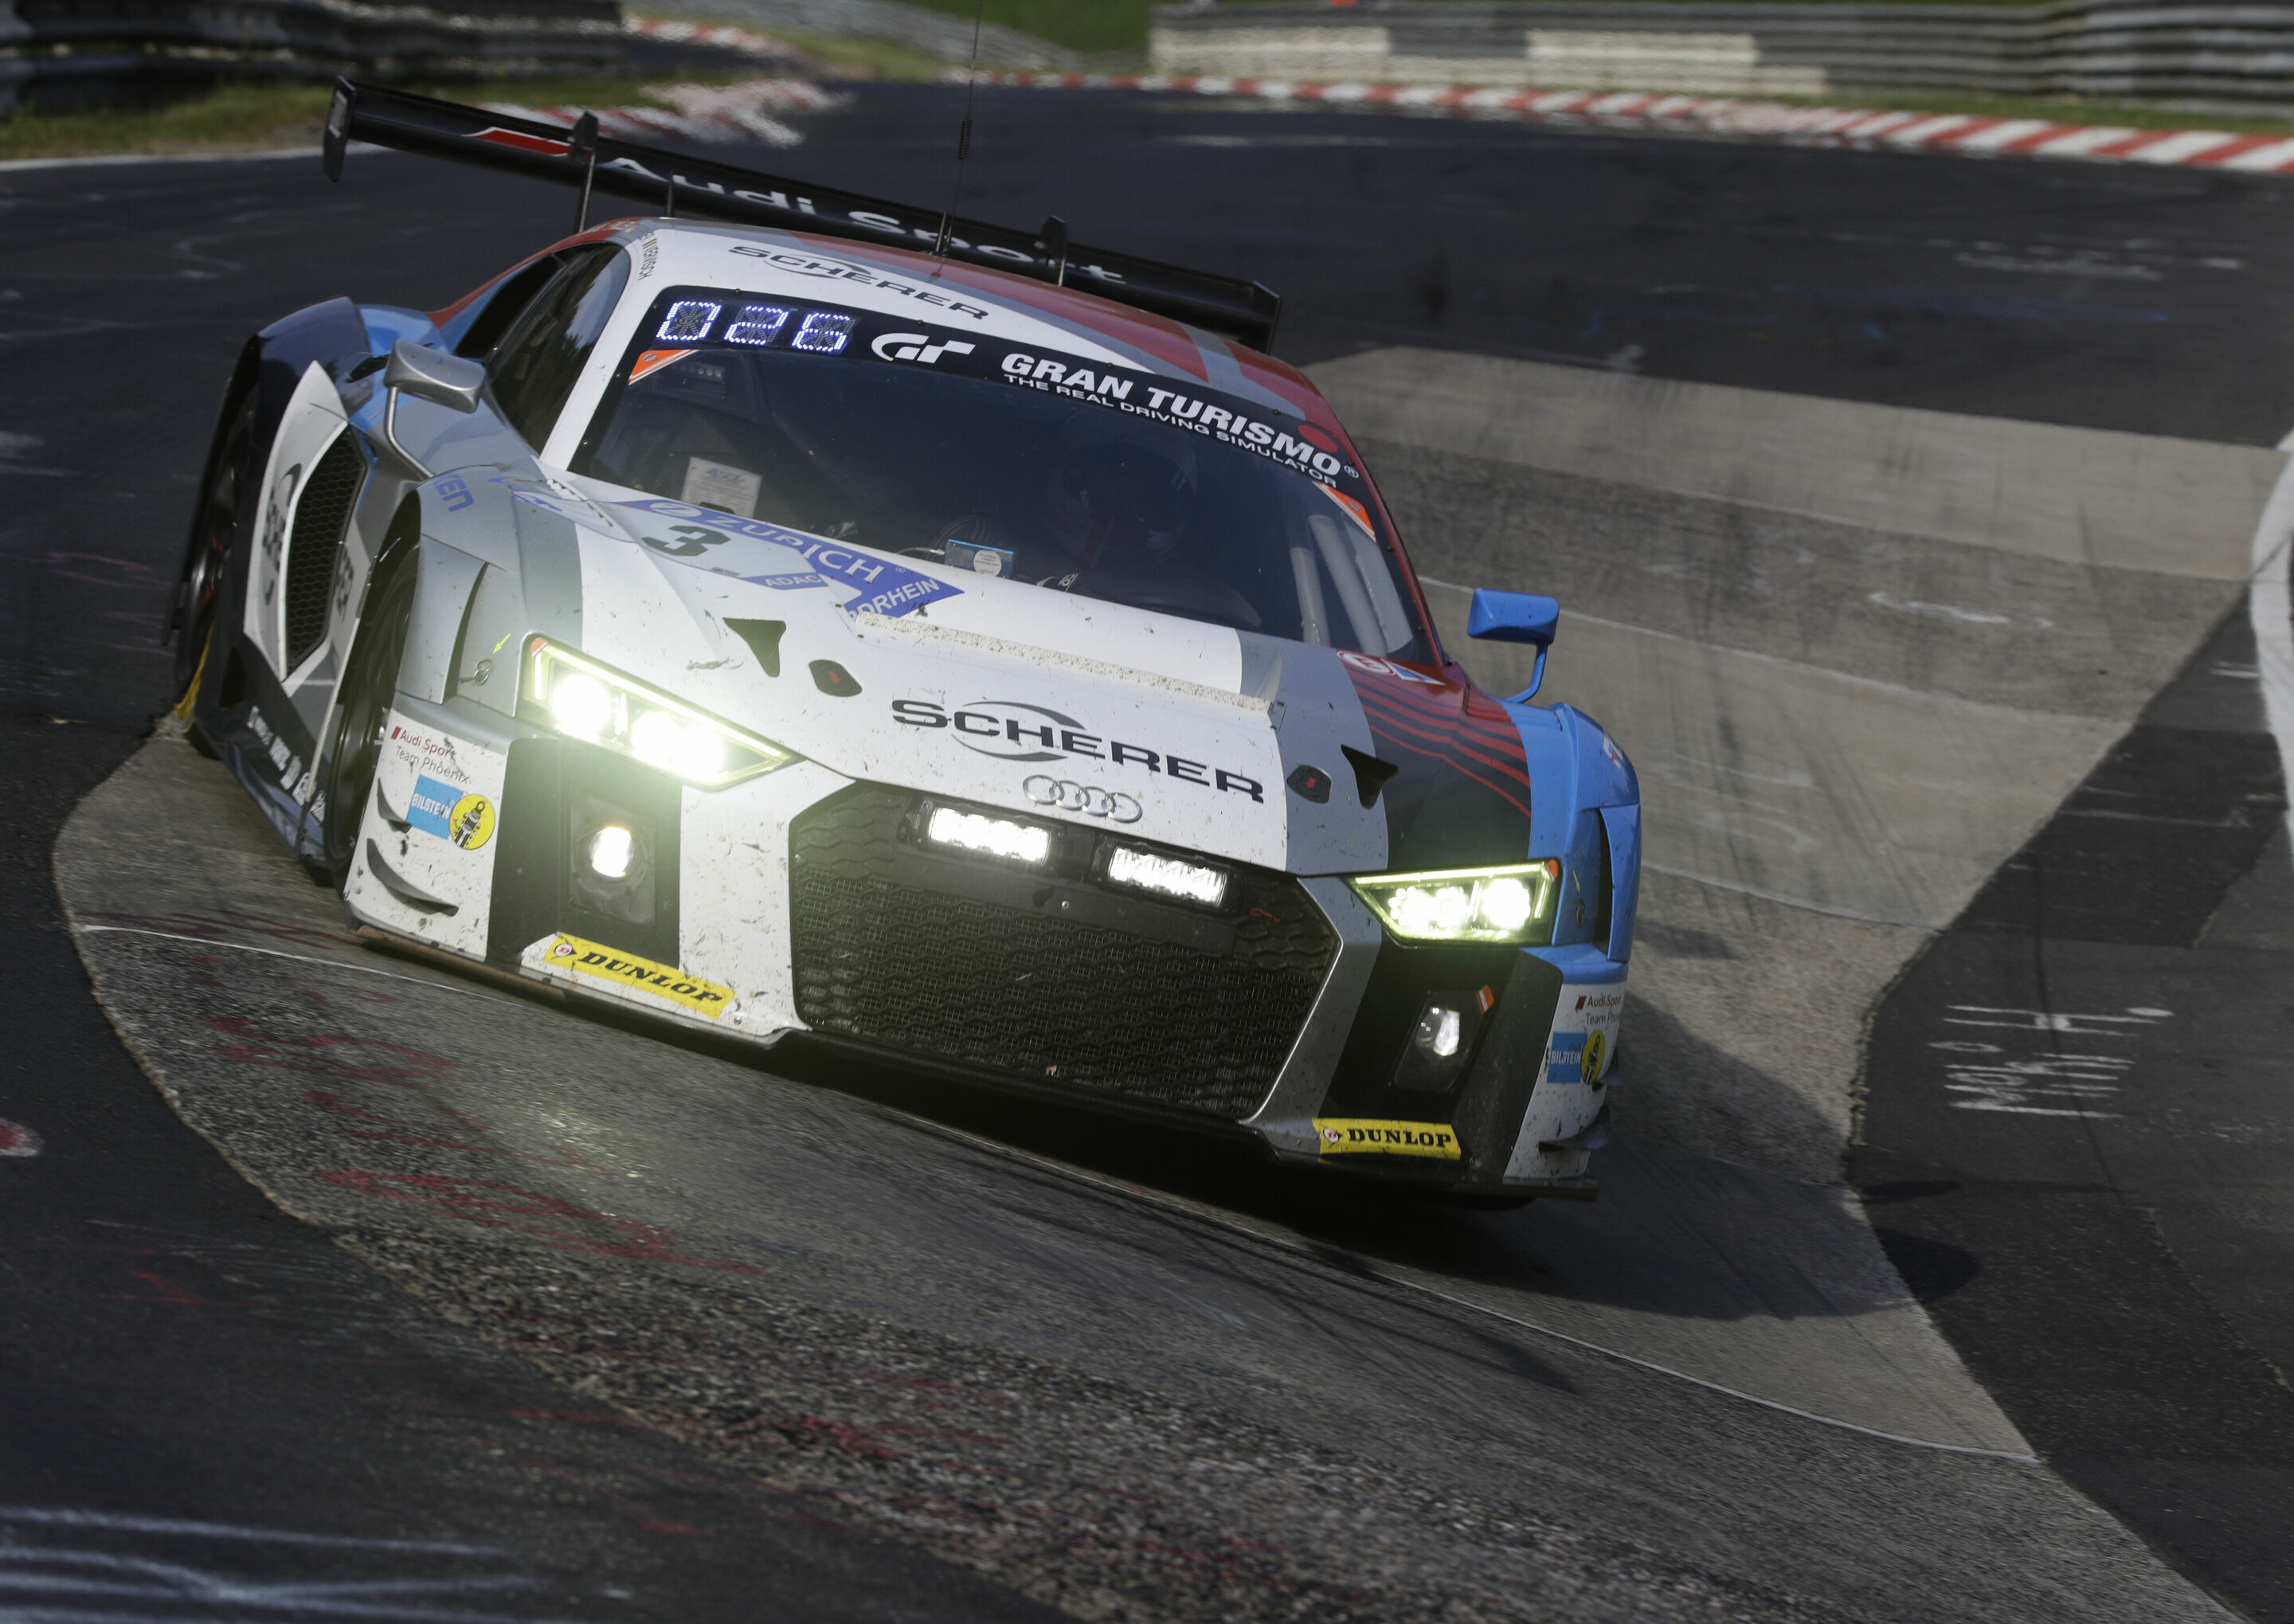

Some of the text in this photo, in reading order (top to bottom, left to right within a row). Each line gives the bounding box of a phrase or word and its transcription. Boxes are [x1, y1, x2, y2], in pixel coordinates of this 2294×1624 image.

[596, 157, 816, 216] Audi
[728, 245, 989, 320] SCHERER
[656, 299, 851, 354] 026
[1000, 352, 1341, 477] GRAN TURISMO
[1004, 374, 1337, 489] THE REAL DRIVING SIMULATOR
[640, 525, 731, 557] 3
[705, 516, 885, 583] ZURICH
[764, 573, 821, 588] ADAC
[397, 745, 419, 765] Team
[400, 730, 457, 758] Audi Sport
[891, 699, 1264, 804] SCHERER
[411, 793, 452, 820] BILSTEIN
[577, 952, 723, 1002] DUNLOP
[1587, 995, 1606, 1008] Audi
[1551, 1051, 1581, 1064] BILSTEIN
[1346, 1128, 1451, 1148] DUNLOP
